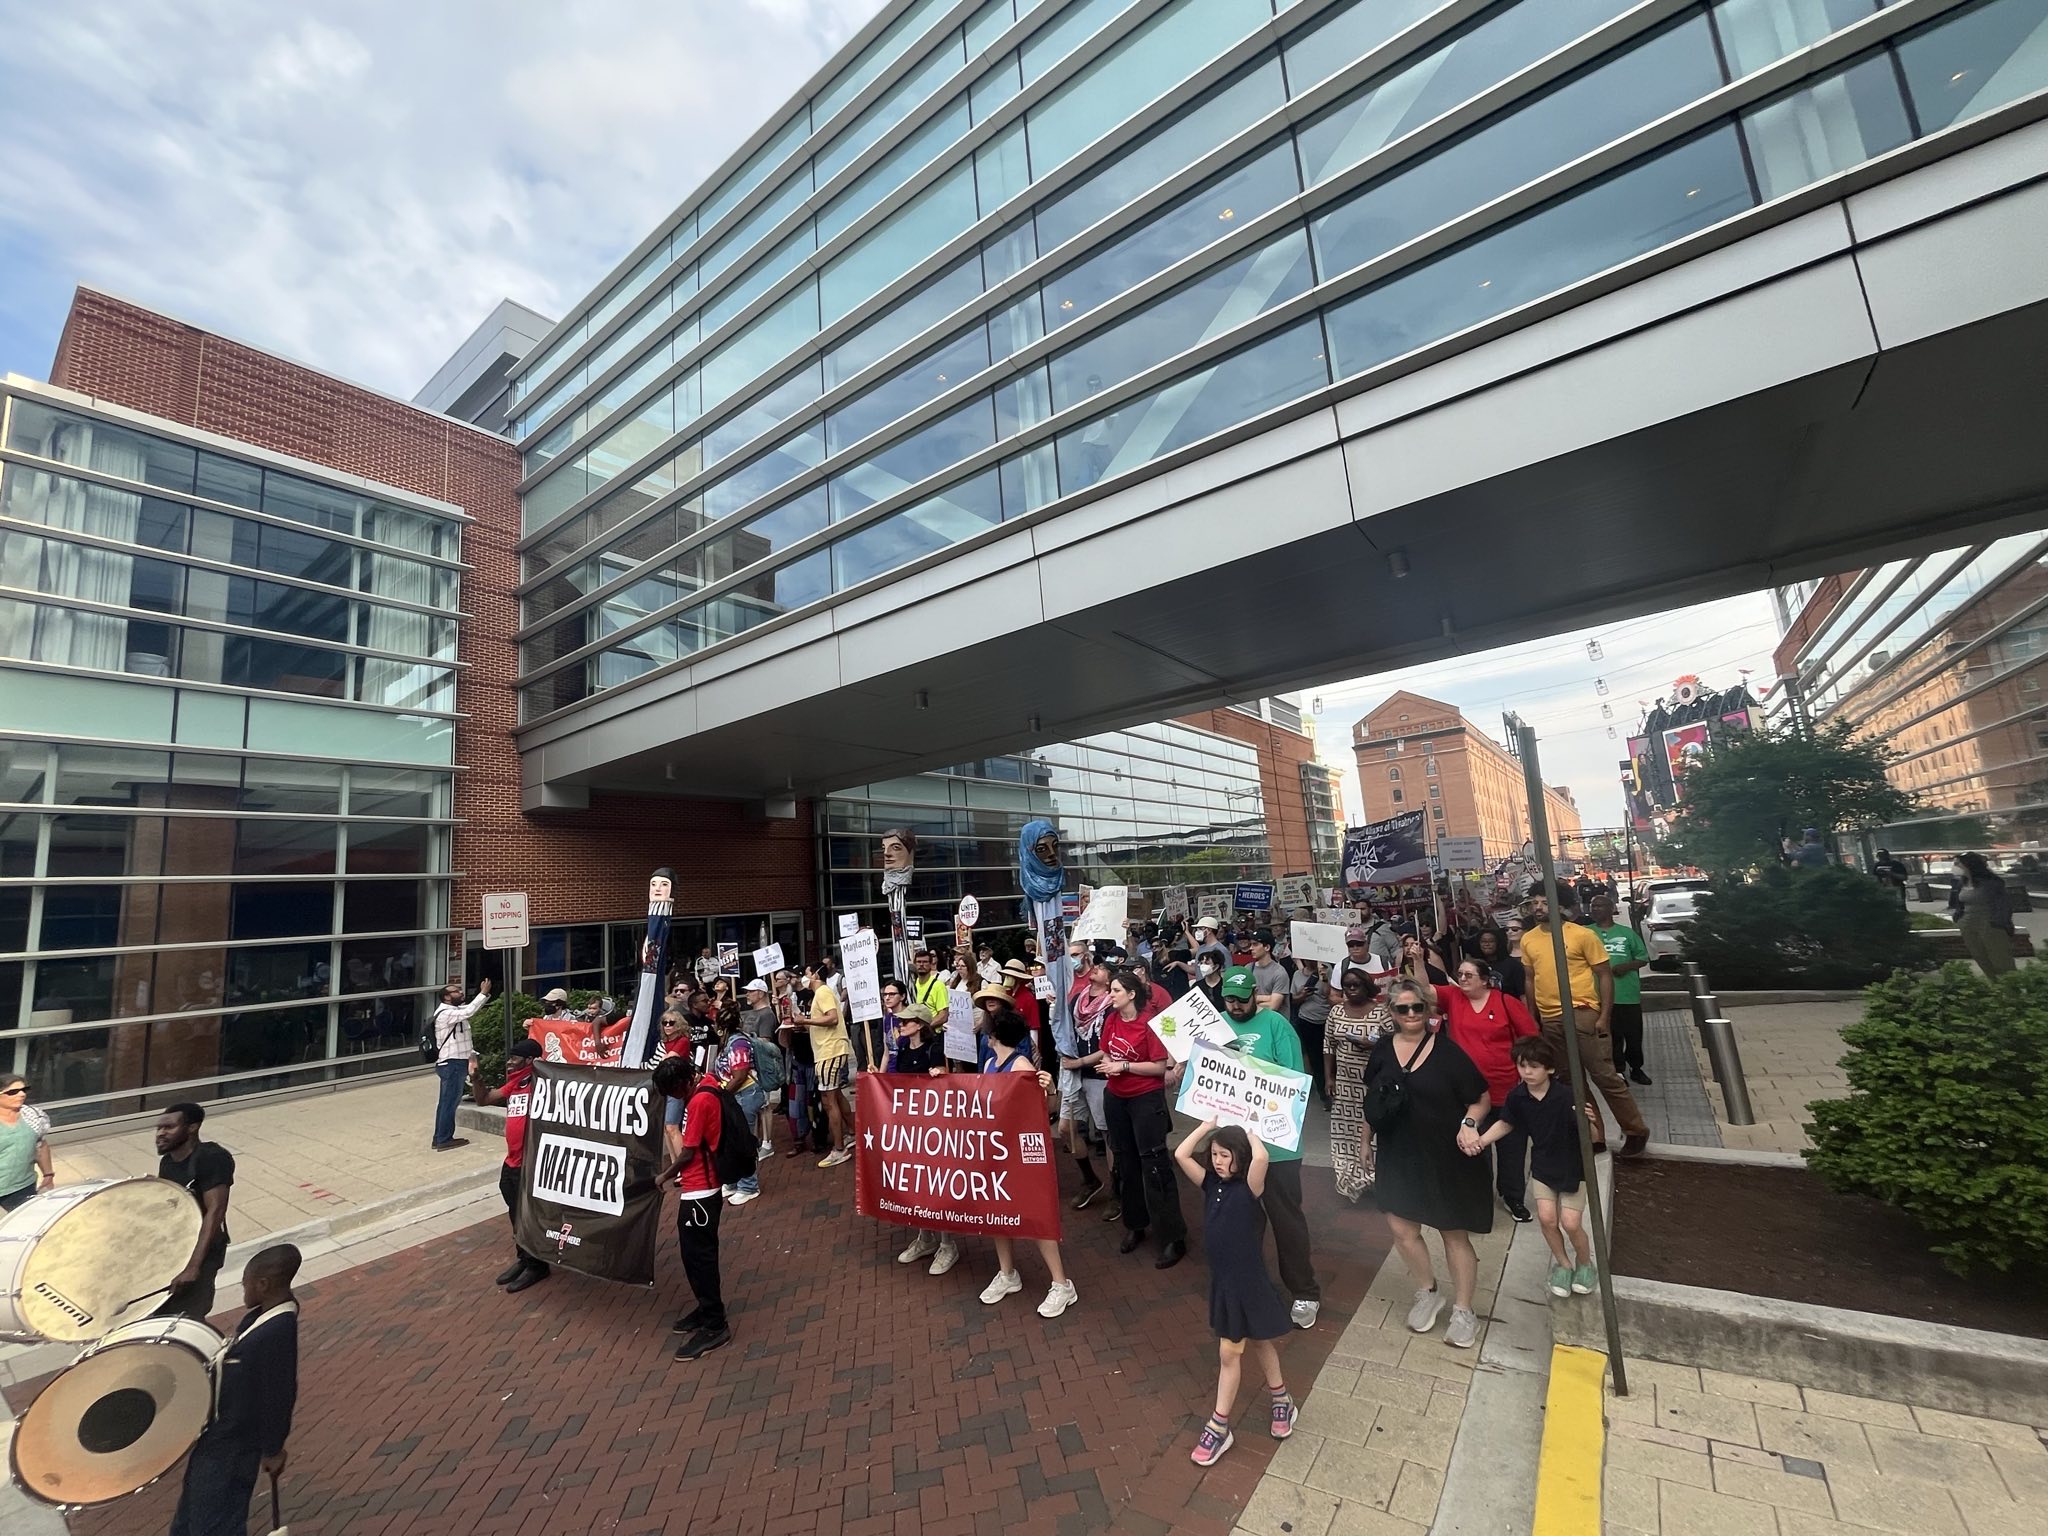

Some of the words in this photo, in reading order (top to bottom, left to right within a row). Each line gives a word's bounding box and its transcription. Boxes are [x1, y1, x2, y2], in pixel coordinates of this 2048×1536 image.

[500, 901, 511, 909] NO
[961, 903, 977, 911] UNITE
[1242, 892, 1265, 900] HEROES
[490, 911, 522, 920] STOPPING
[961, 911, 978, 919] HERE!
[849, 957, 869, 970] Stands
[854, 980, 868, 991] With
[1186, 993, 1220, 1027] HAPPY
[1183, 1018, 1210, 1043] MAY
[1197, 1074, 1236, 1098] GOTTA
[1244, 1090, 1266, 1109] GO!
[1201, 1056, 1247, 1081] DONALD
[1254, 1076, 1308, 1102] TRUMP'S
[530, 1077, 594, 1128] BLACK
[590, 1084, 650, 1137] LIVES
[892, 1088, 995, 1120] FEDERAL
[880, 1123, 1009, 1161] UNIONISTS
[1022, 1135, 1043, 1147] FUN
[538, 1144, 620, 1203] MATTER
[881, 1161, 1012, 1201] NETWORK
[879, 1199, 912, 1216] Baltimore
[913, 1205, 943, 1220] Federal
[945, 1210, 984, 1225] Workers
[986, 1213, 1021, 1226] United
[546, 1229, 561, 1241] UNITE
